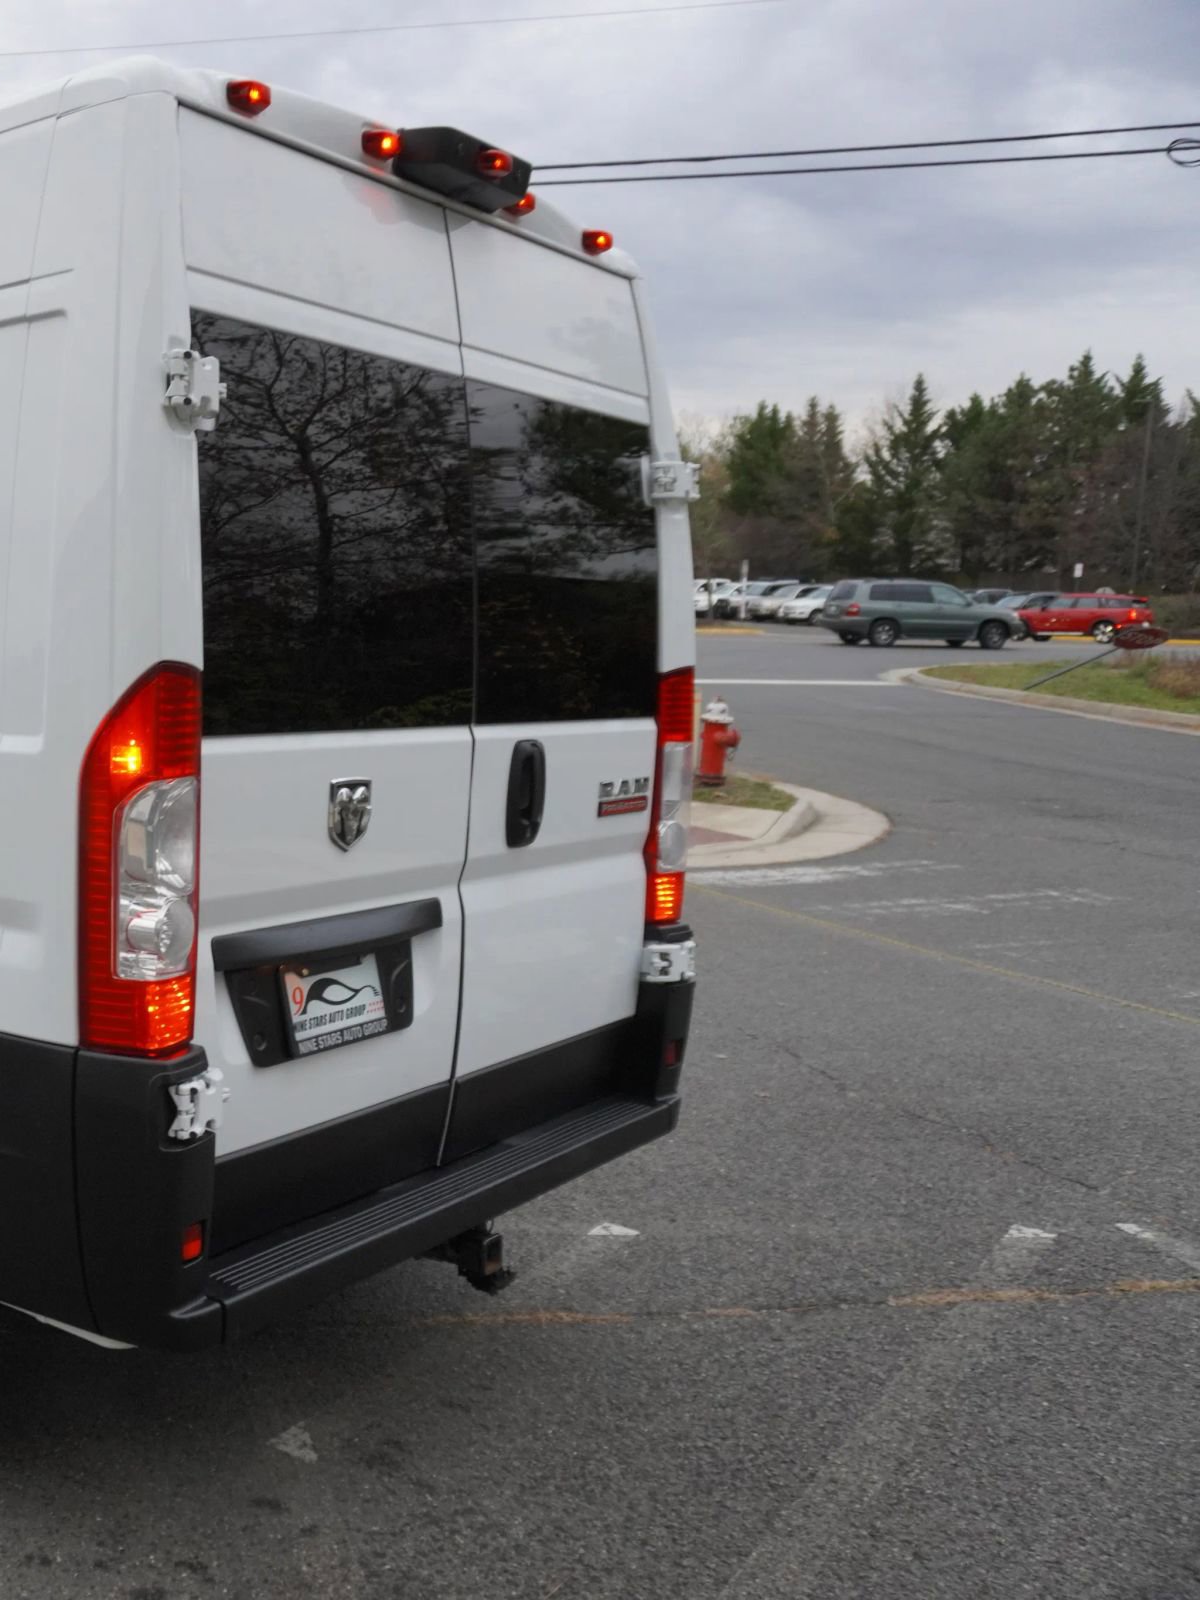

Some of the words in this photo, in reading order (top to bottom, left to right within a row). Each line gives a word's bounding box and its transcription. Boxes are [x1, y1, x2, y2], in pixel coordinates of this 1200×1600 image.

[292, 986, 304, 1016] 9
[308, 1014, 327, 1030] STARS
[328, 1010, 344, 1024] AUTO
[346, 1004, 366, 1019] GROUP
[299, 1038, 318, 1055] NINE
[318, 1031, 342, 1049] STARS
[344, 1025, 363, 1042] AUTO
[364, 1018, 388, 1036] GROUP
